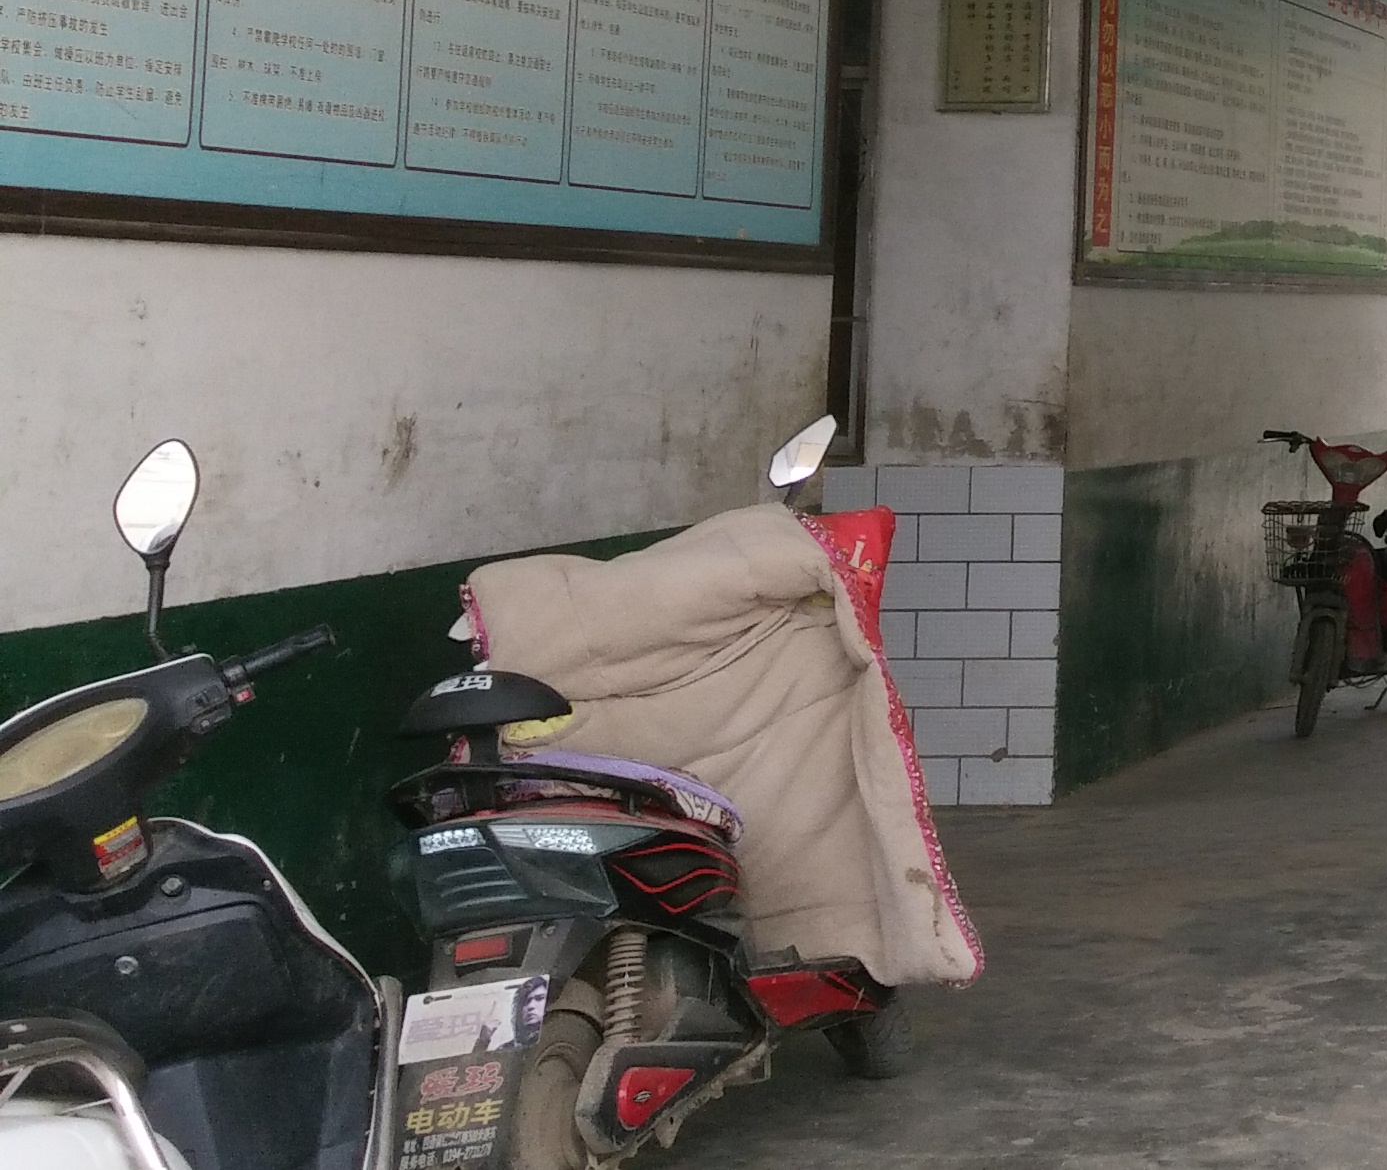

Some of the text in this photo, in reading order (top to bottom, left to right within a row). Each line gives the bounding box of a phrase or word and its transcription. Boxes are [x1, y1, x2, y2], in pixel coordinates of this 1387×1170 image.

[420, 1061, 504, 1104] 爱玛
[404, 1097, 504, 1135] 电动车
